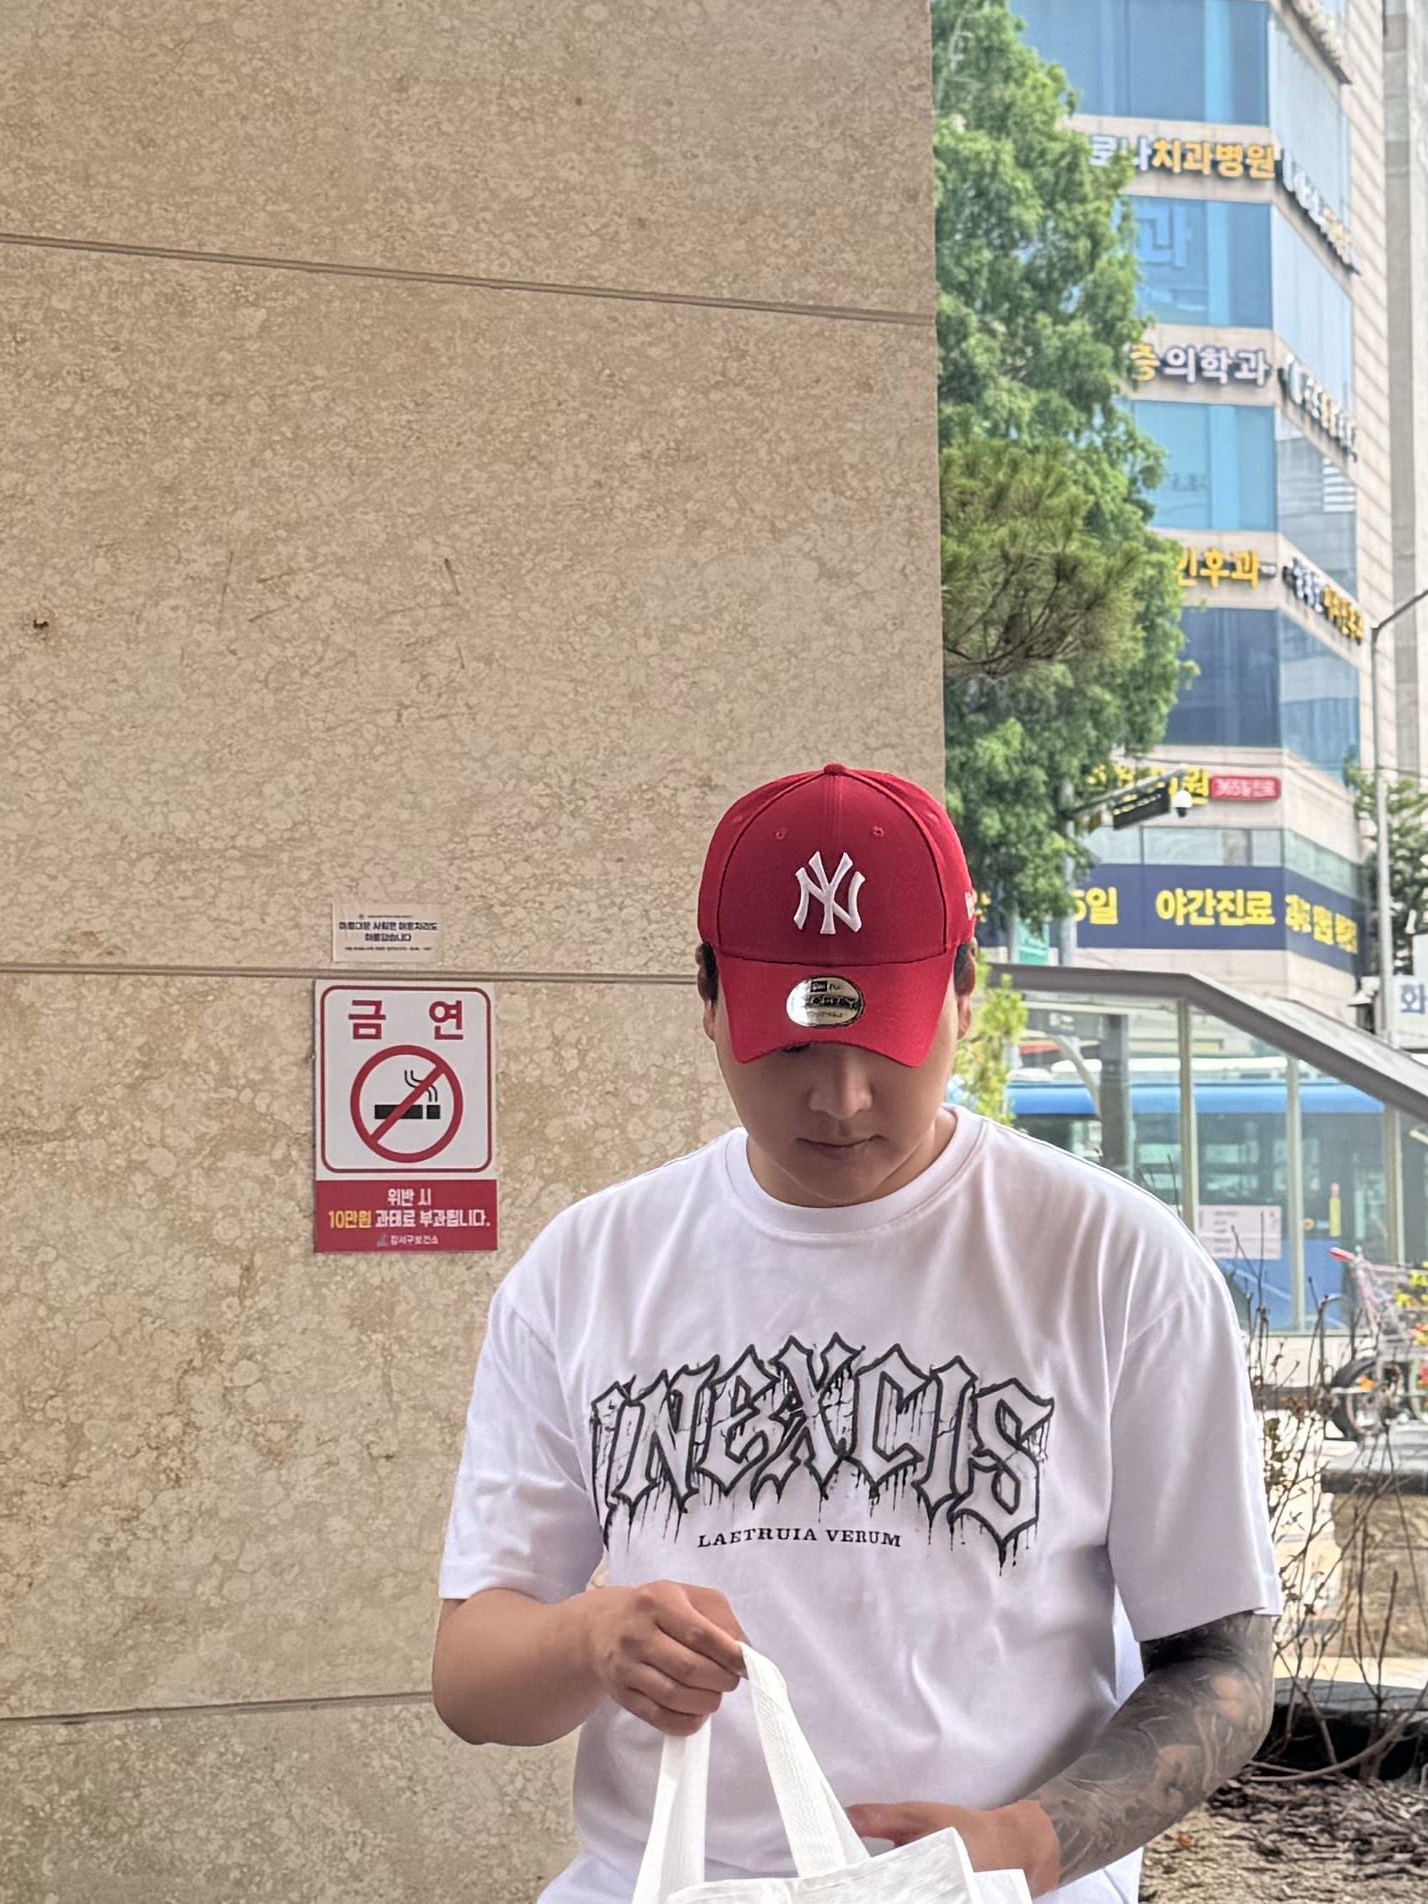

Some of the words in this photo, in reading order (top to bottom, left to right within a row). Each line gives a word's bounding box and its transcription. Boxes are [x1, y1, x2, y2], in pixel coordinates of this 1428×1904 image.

[793, 850, 866, 936] NY
[1155, 888, 1276, 926] 야간진료
[387, 1188, 415, 1207] 위반
[418, 1188, 432, 1206] 시
[328, 1209, 372, 1229] 10만원
[375, 1209, 416, 1228] 과태료
[825, 1529, 902, 1548] VERUM
